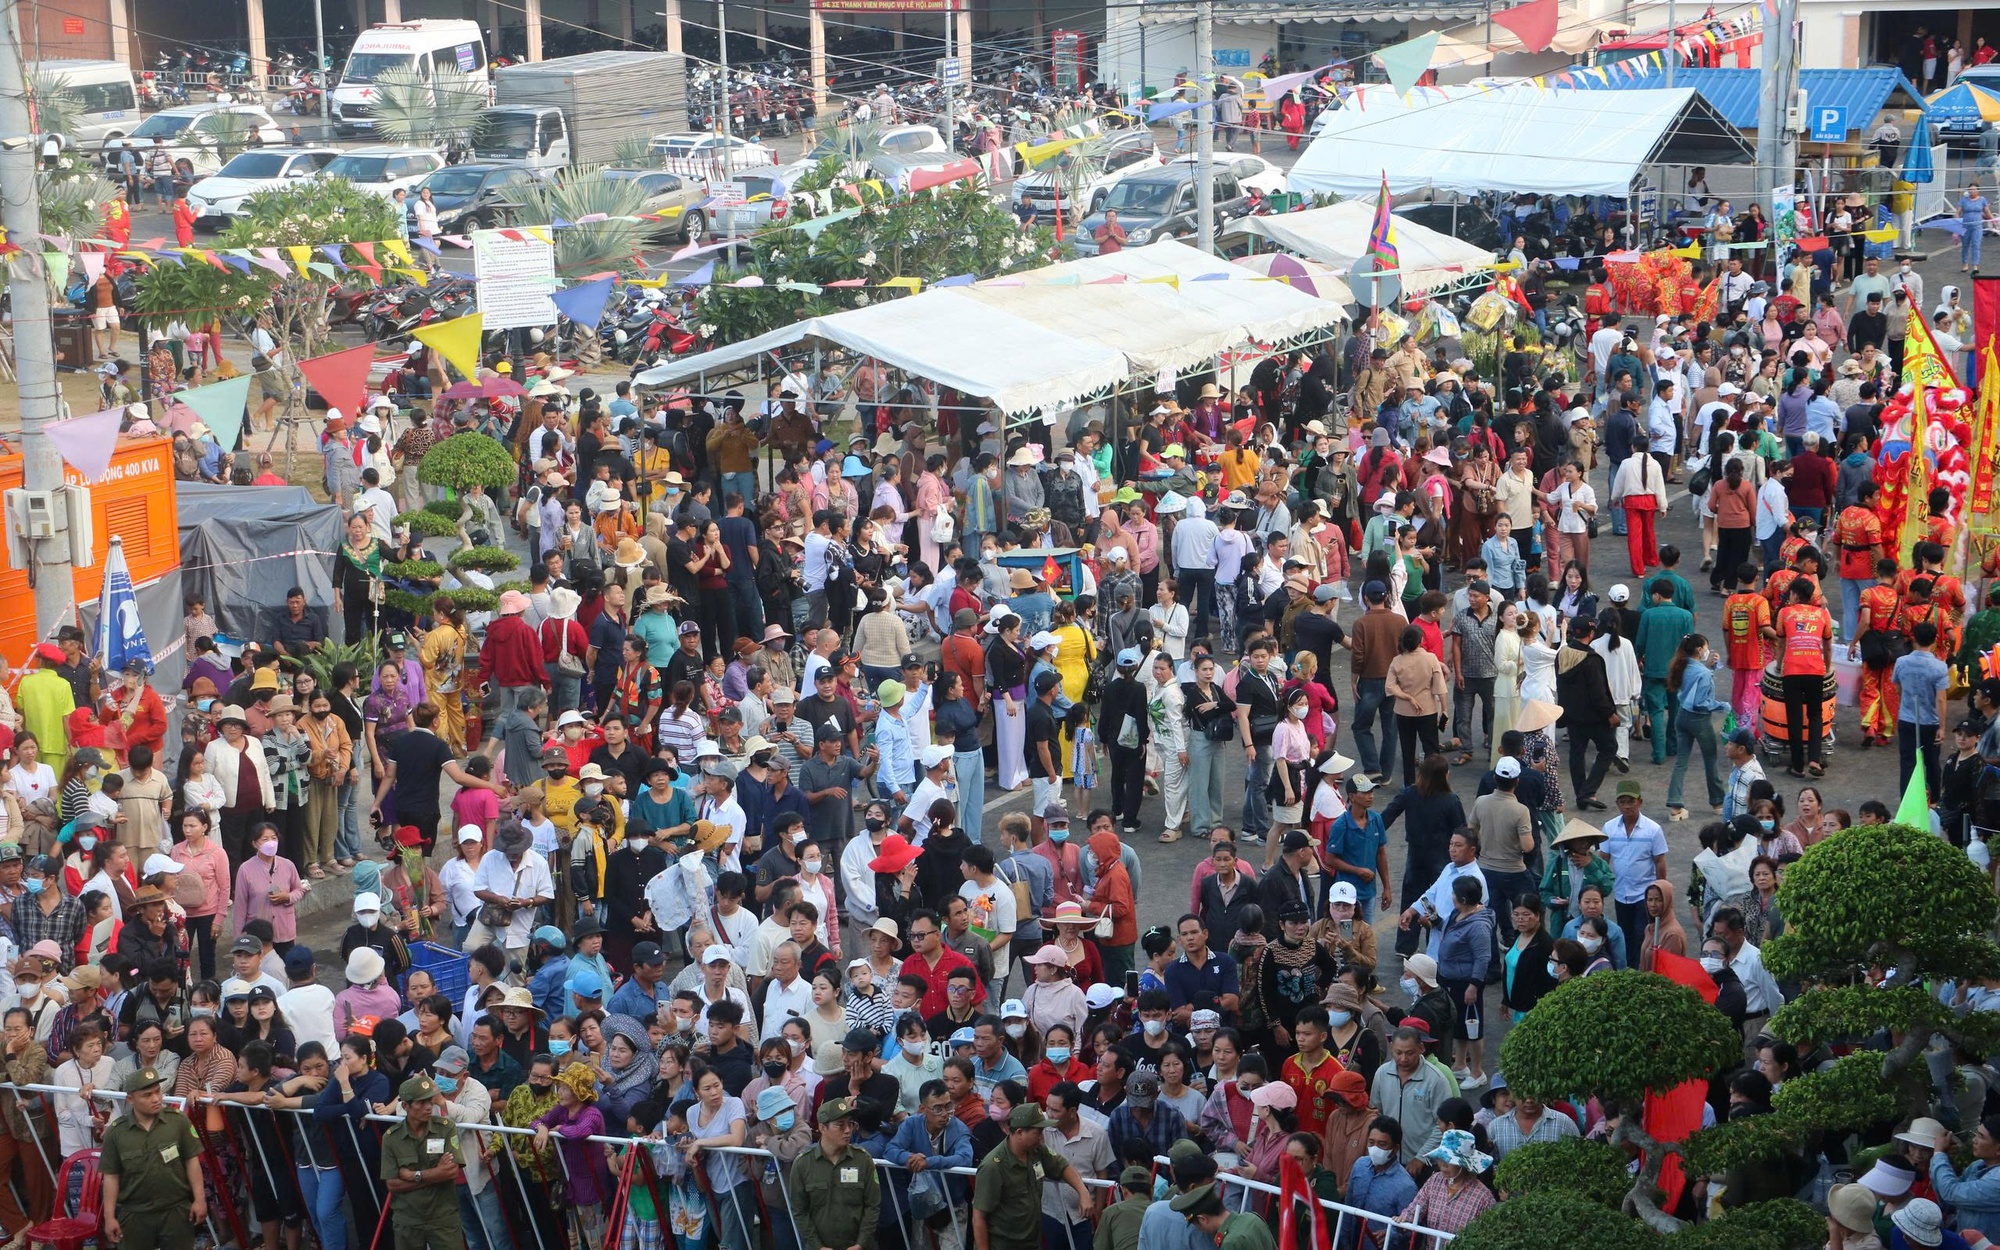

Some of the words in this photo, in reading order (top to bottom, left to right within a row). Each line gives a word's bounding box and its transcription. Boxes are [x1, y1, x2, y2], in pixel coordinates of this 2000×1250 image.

[1820, 109, 1840, 132] P
[125, 462, 140, 476] 400
[142, 457, 160, 474] KVA
